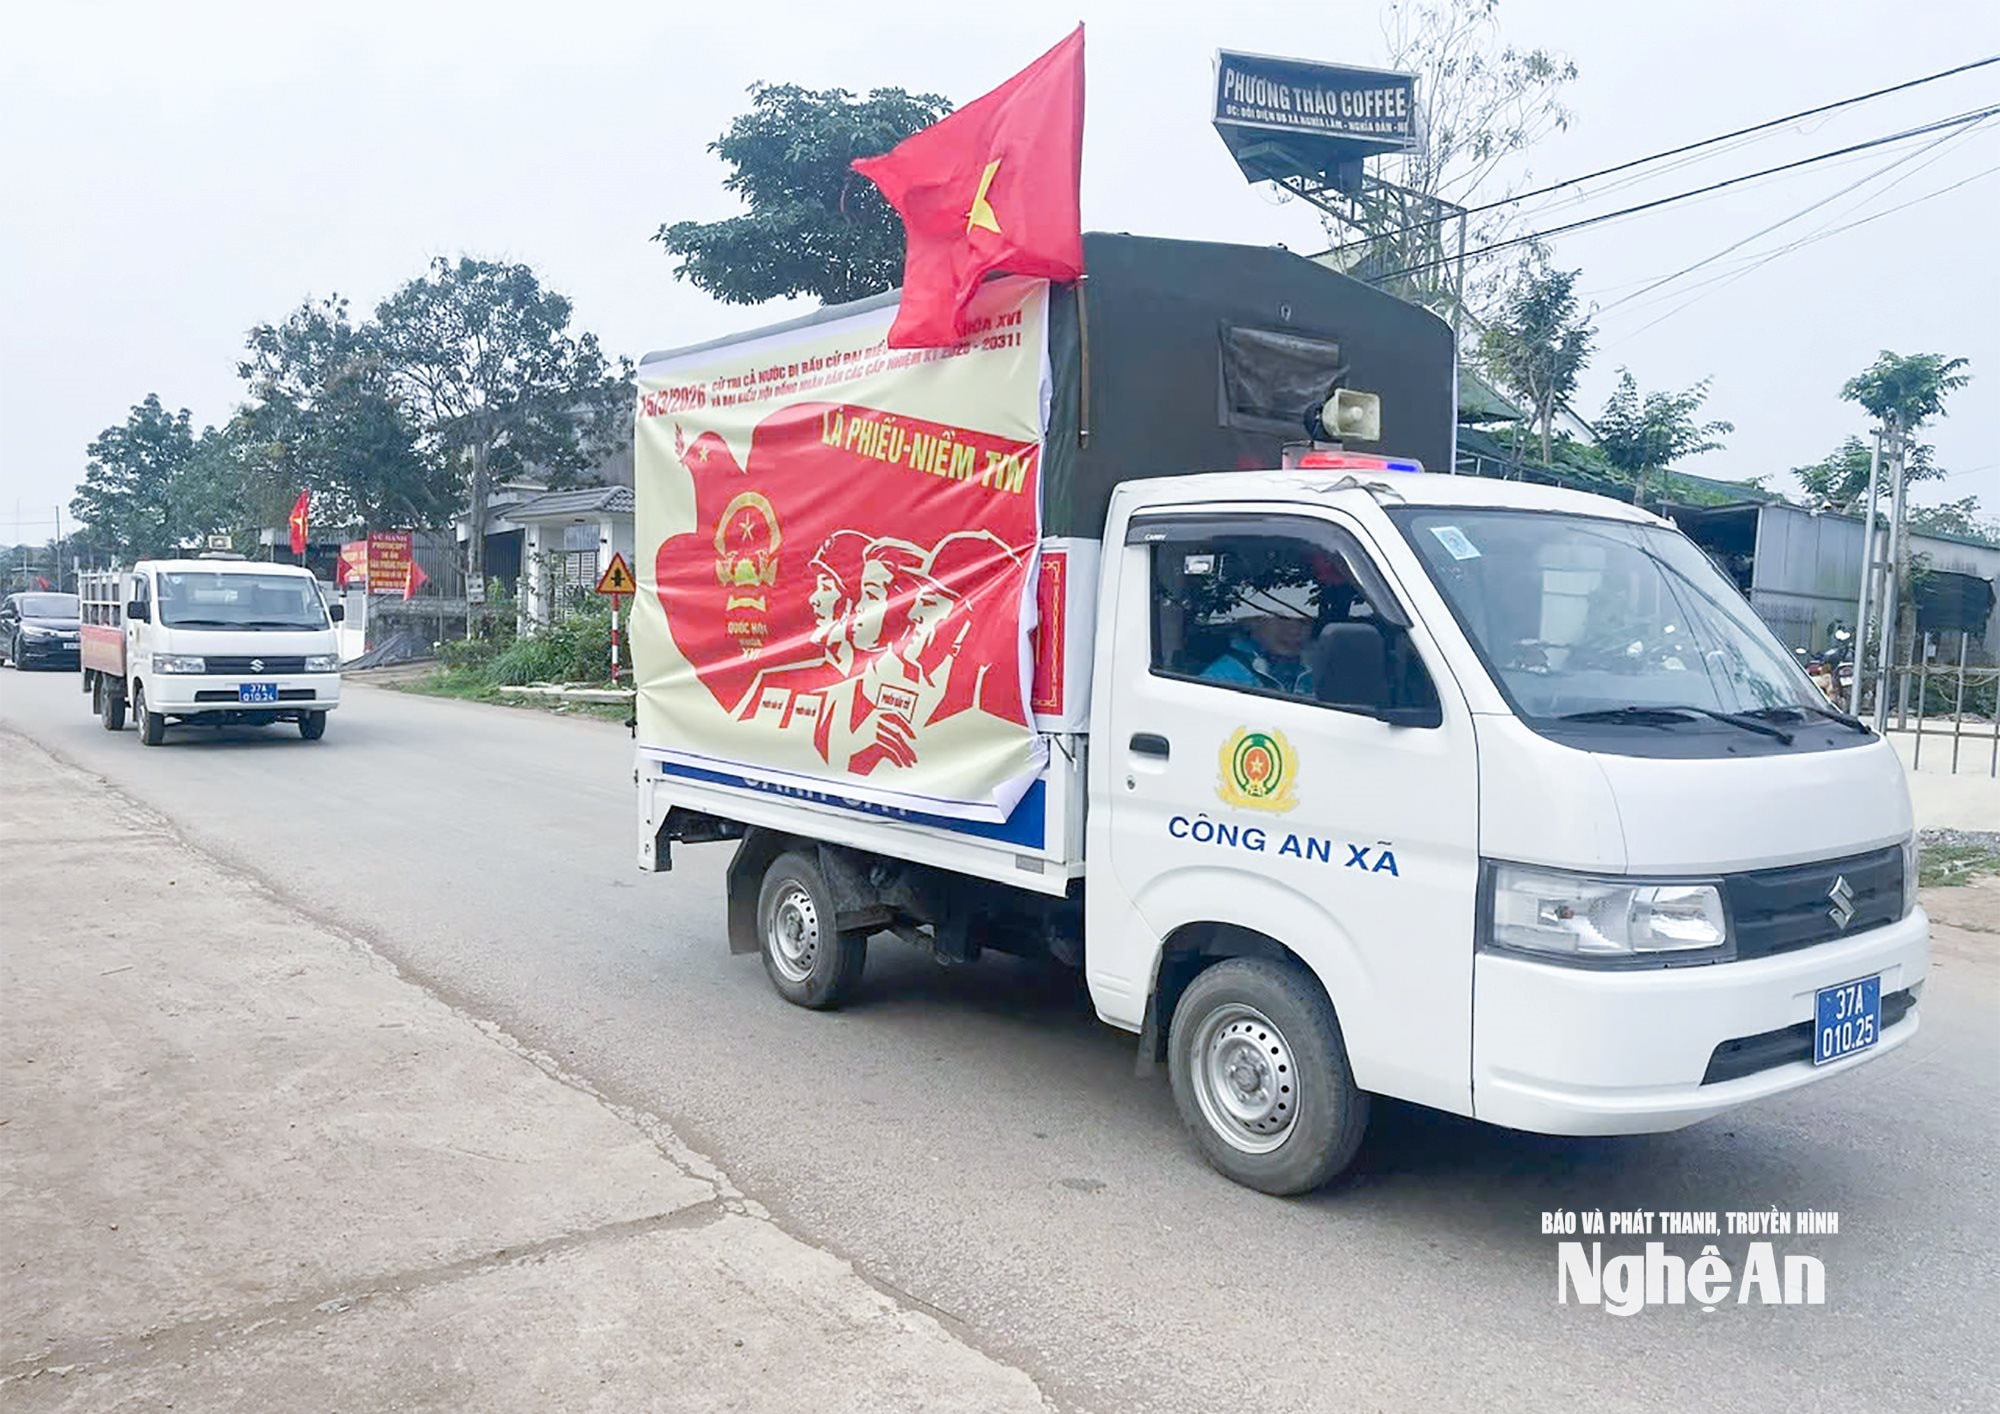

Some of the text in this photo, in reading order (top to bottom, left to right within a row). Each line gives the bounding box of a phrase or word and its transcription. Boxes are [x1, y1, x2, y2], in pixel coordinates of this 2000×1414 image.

[1224, 68, 1406, 117] PHƯƠNG THẢO COFFEE
[996, 309, 1022, 328] XVI
[981, 450, 1030, 494] TIN
[1168, 812, 1400, 877] CÔNG AN XÃ
[1836, 984, 1864, 1020] 37A
[1822, 1014, 1874, 1058] 010.25
